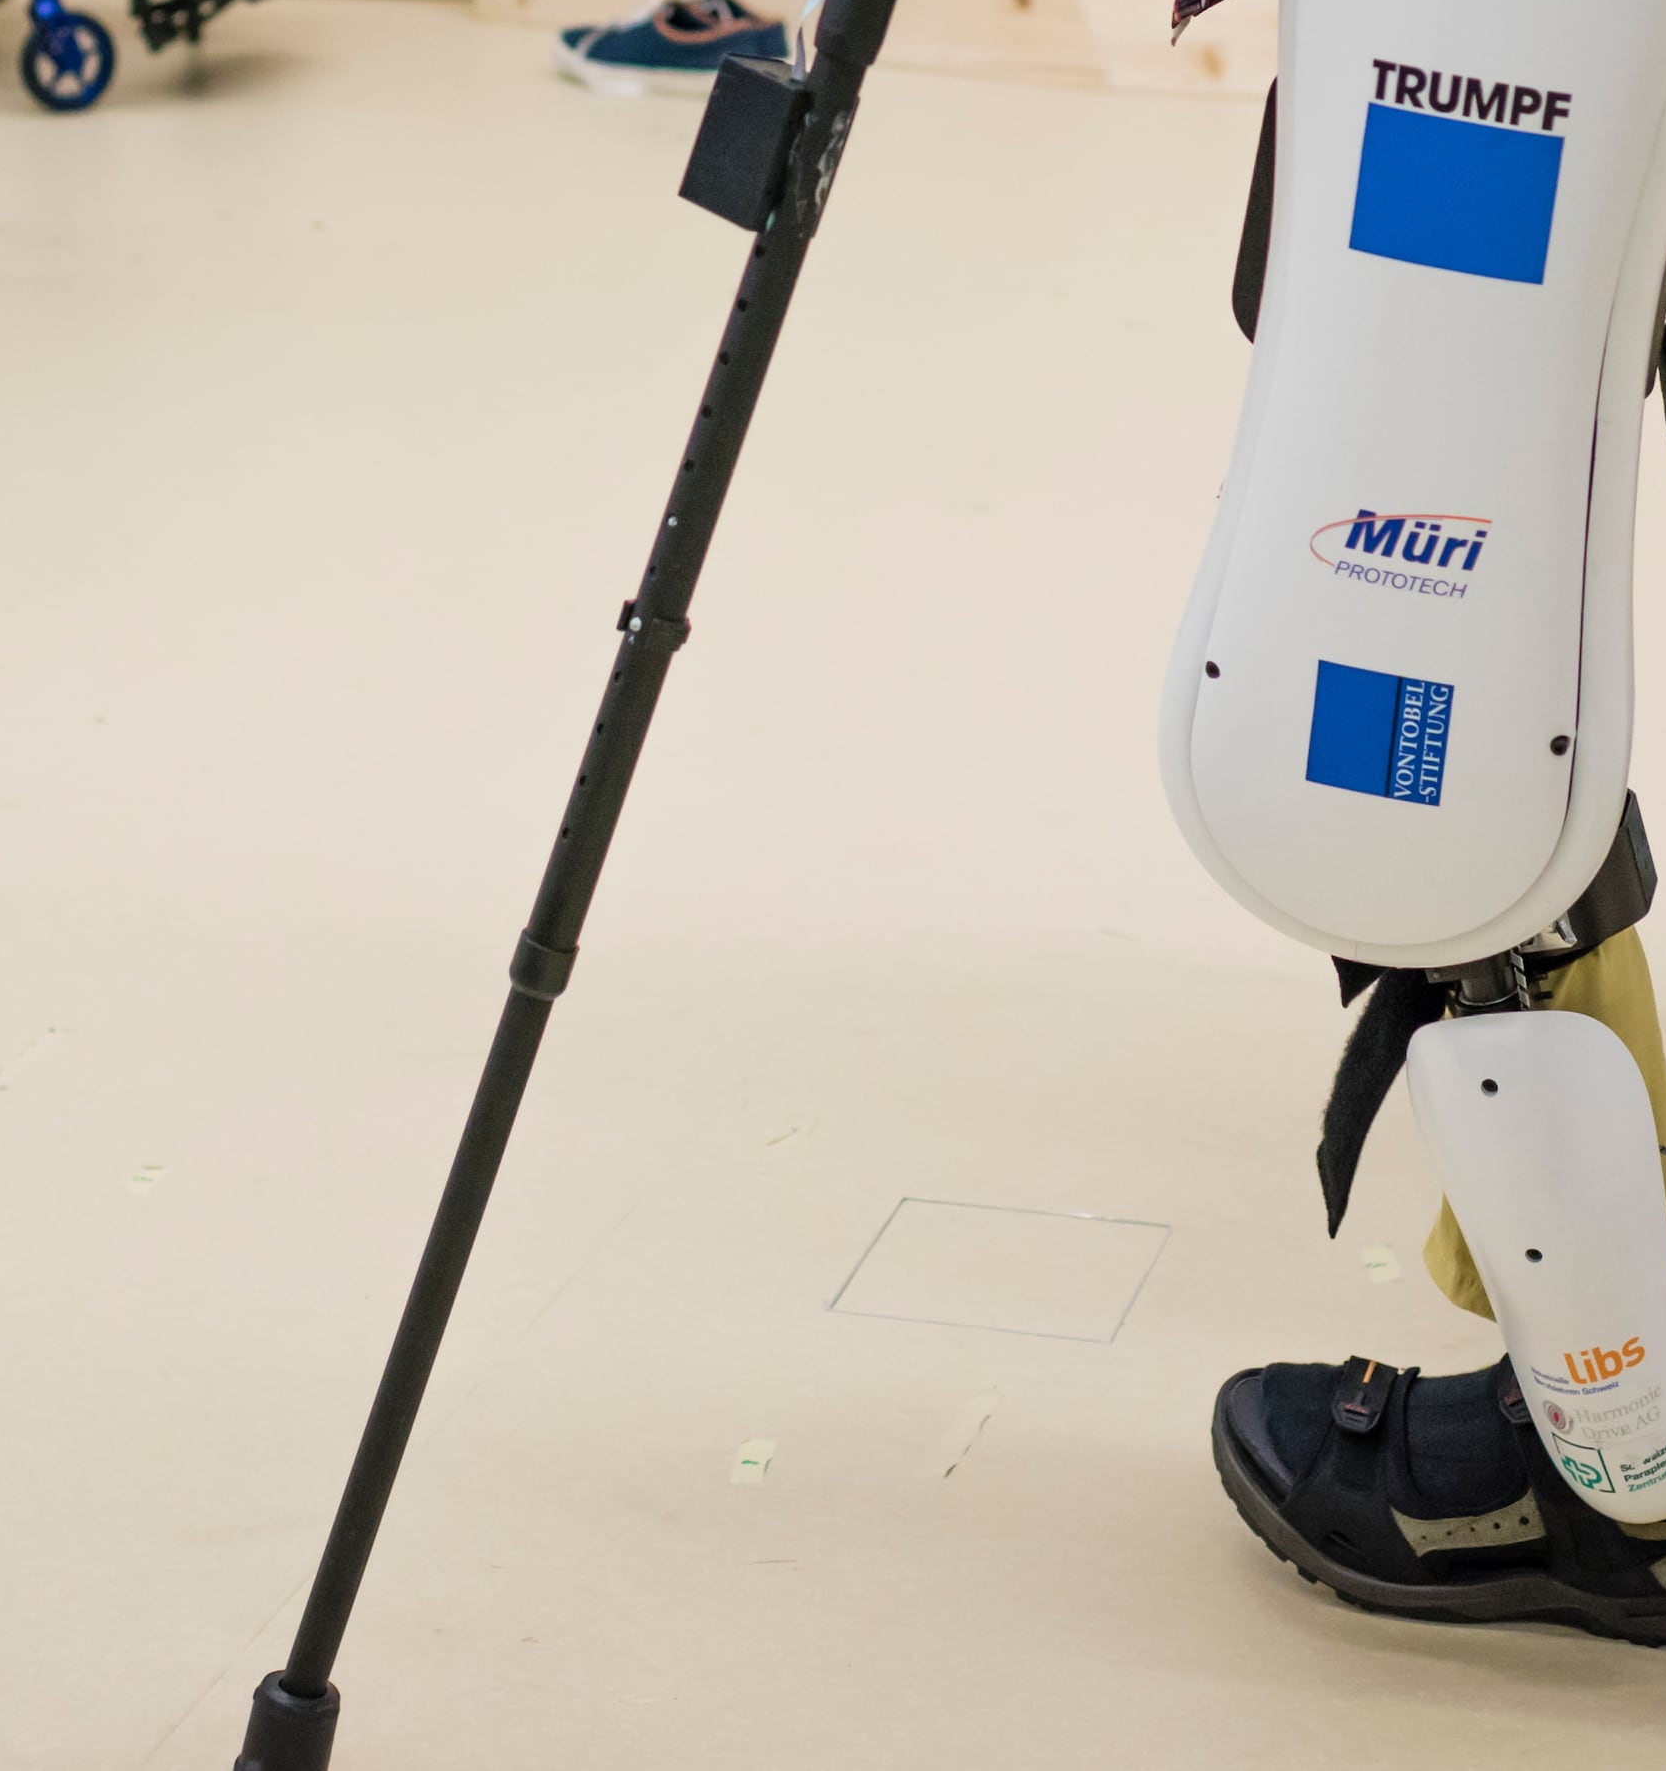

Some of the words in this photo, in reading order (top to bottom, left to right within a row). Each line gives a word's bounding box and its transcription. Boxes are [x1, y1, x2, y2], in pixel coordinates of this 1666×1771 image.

[1372, 58, 1572, 132] TRUMPF
[1344, 508, 1488, 572] Müri
[1334, 560, 1468, 599] PROTOTECH
[1393, 681, 1426, 799] VONTOBEL
[1563, 1336, 1646, 1385] libs
[1575, 1386, 1662, 1424] Harmonic
[1581, 1424, 1632, 1441] Drive
[1636, 1405, 1661, 1430] AG
